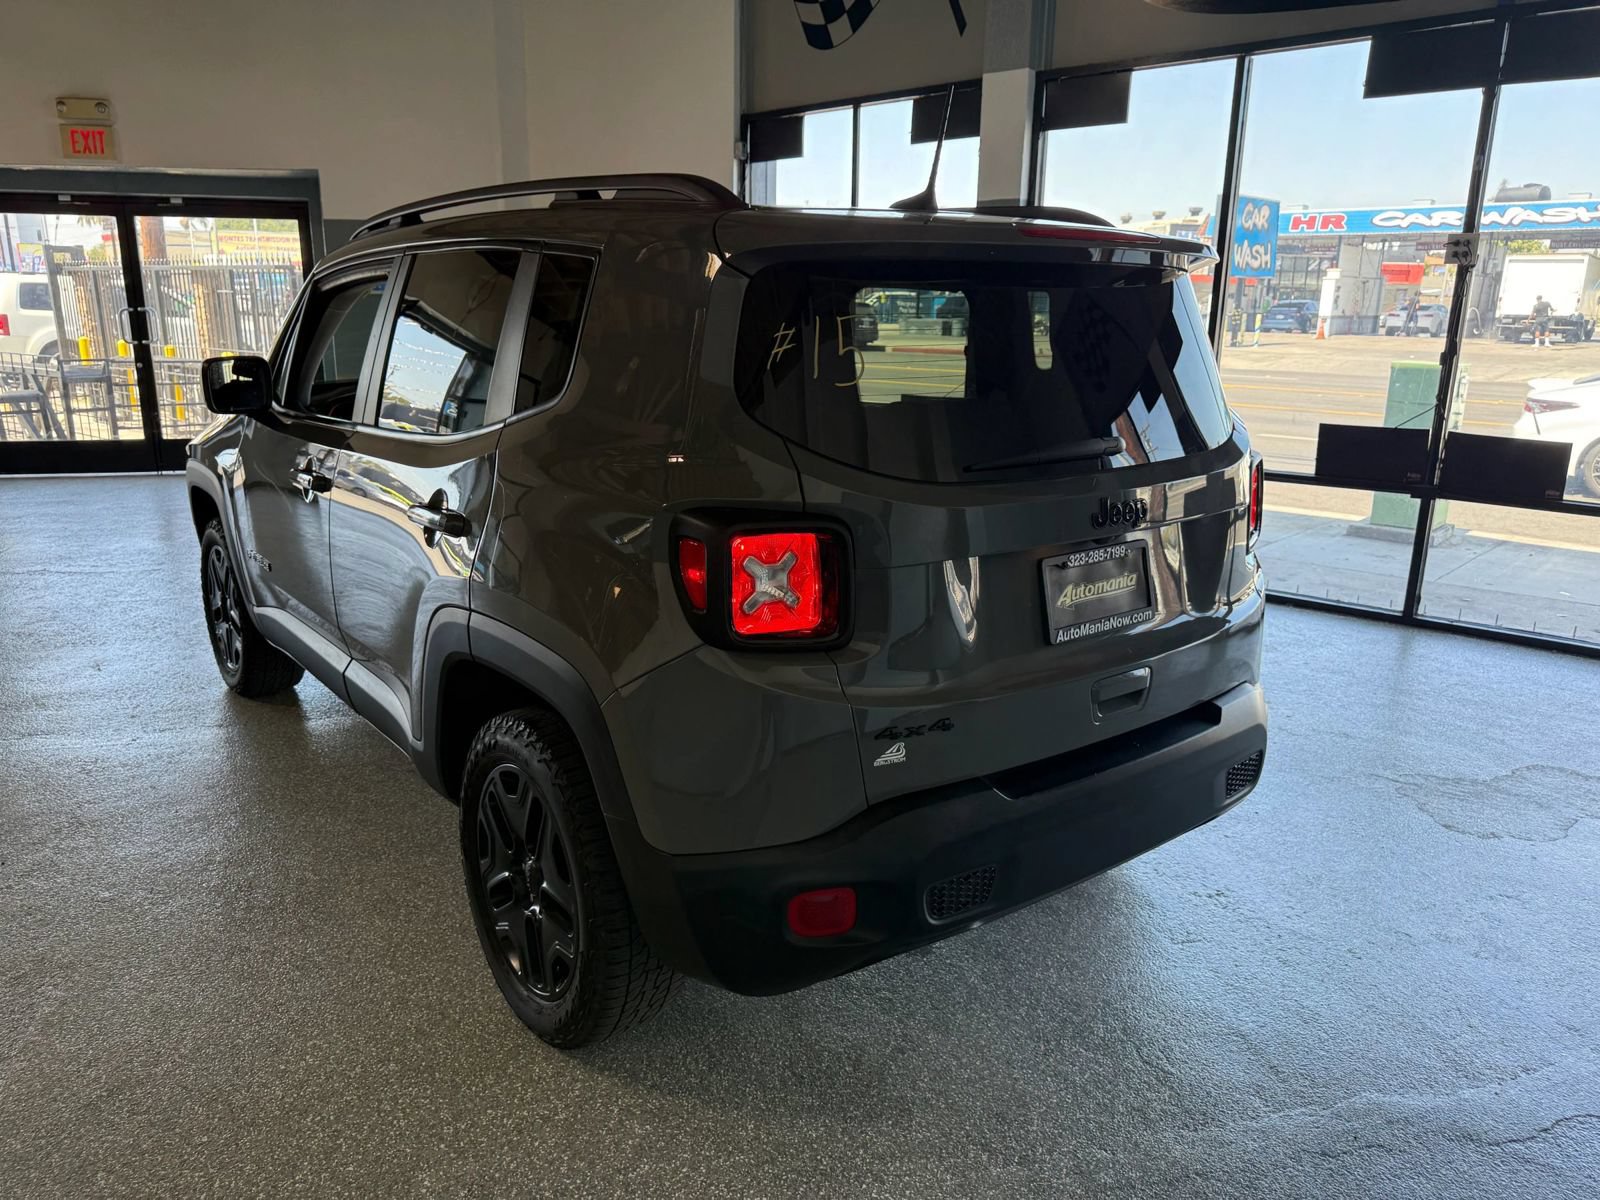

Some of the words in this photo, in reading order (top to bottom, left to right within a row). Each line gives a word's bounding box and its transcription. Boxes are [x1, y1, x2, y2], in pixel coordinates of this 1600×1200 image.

[69, 129, 105, 155] EXIT
[1241, 202, 1270, 232] CAR
[1289, 213, 1347, 232] HR
[1371, 211, 1463, 228] CAR
[1481, 206, 1600, 226] WASH
[1234, 240, 1271, 270] WASH
[1091, 496, 1148, 529] Jeep
[1067, 546, 1126, 567] 323-285-7199
[1056, 572, 1138, 609] Automania
[1056, 609, 1153, 644] AutoManiaNow.com
